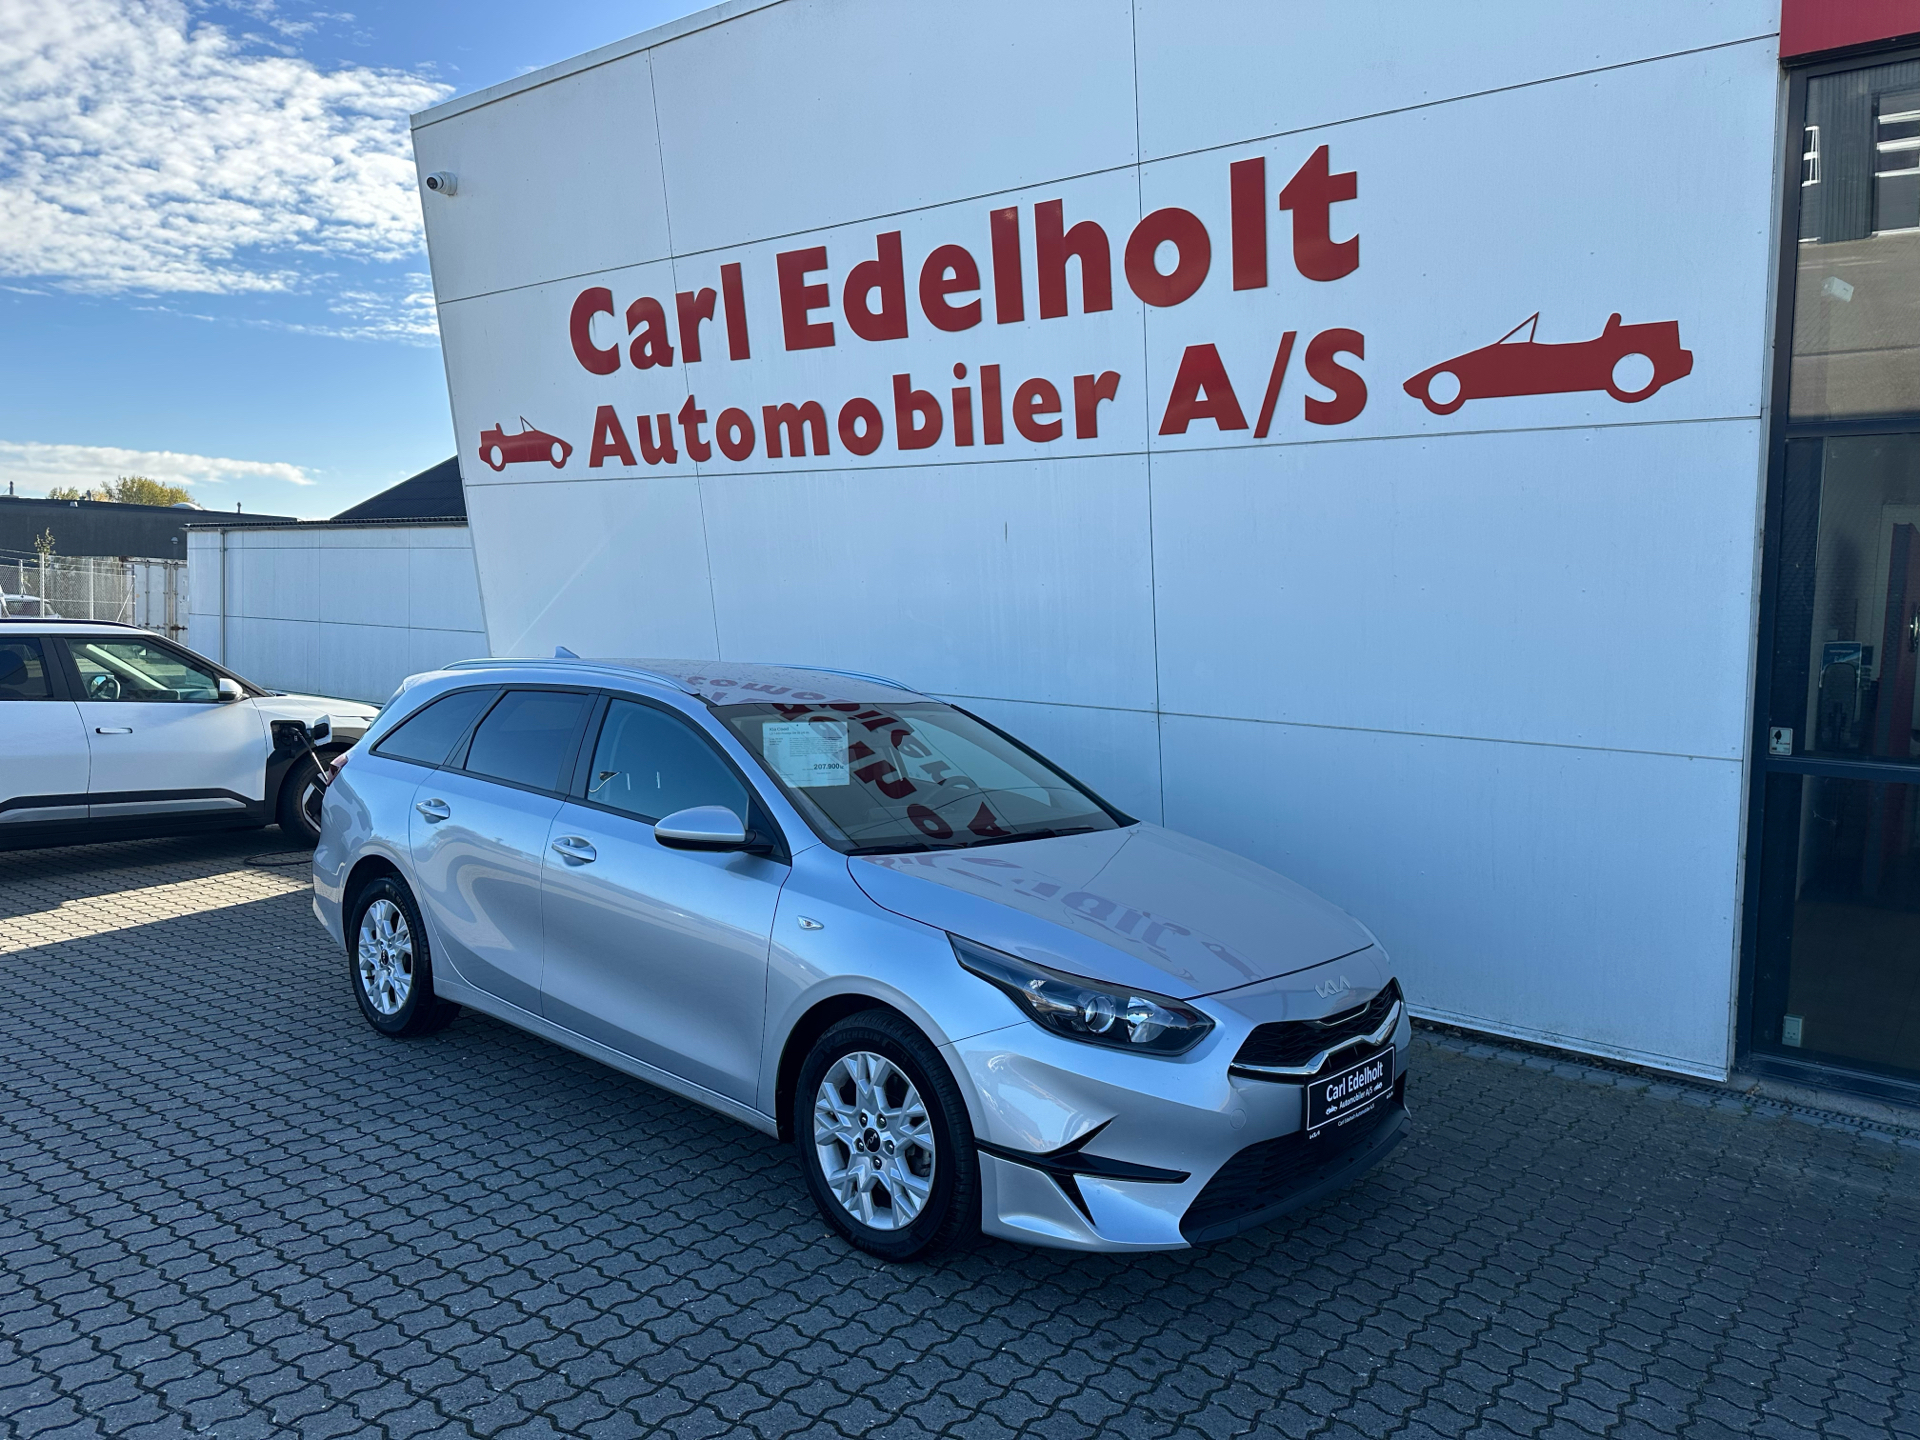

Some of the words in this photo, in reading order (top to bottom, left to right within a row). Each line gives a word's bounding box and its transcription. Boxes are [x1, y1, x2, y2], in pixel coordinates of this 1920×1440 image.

[569, 262, 750, 375] Carl
[776, 145, 1359, 352] Edelholt
[589, 362, 1120, 467] Automobiler
[1158, 327, 1367, 438] A/S
[1314, 974, 1351, 999] KIA
[1326, 1077, 1346, 1102] Carl
[1348, 1060, 1384, 1093] Edelholt
[1339, 1089, 1366, 1110] Automobiler
